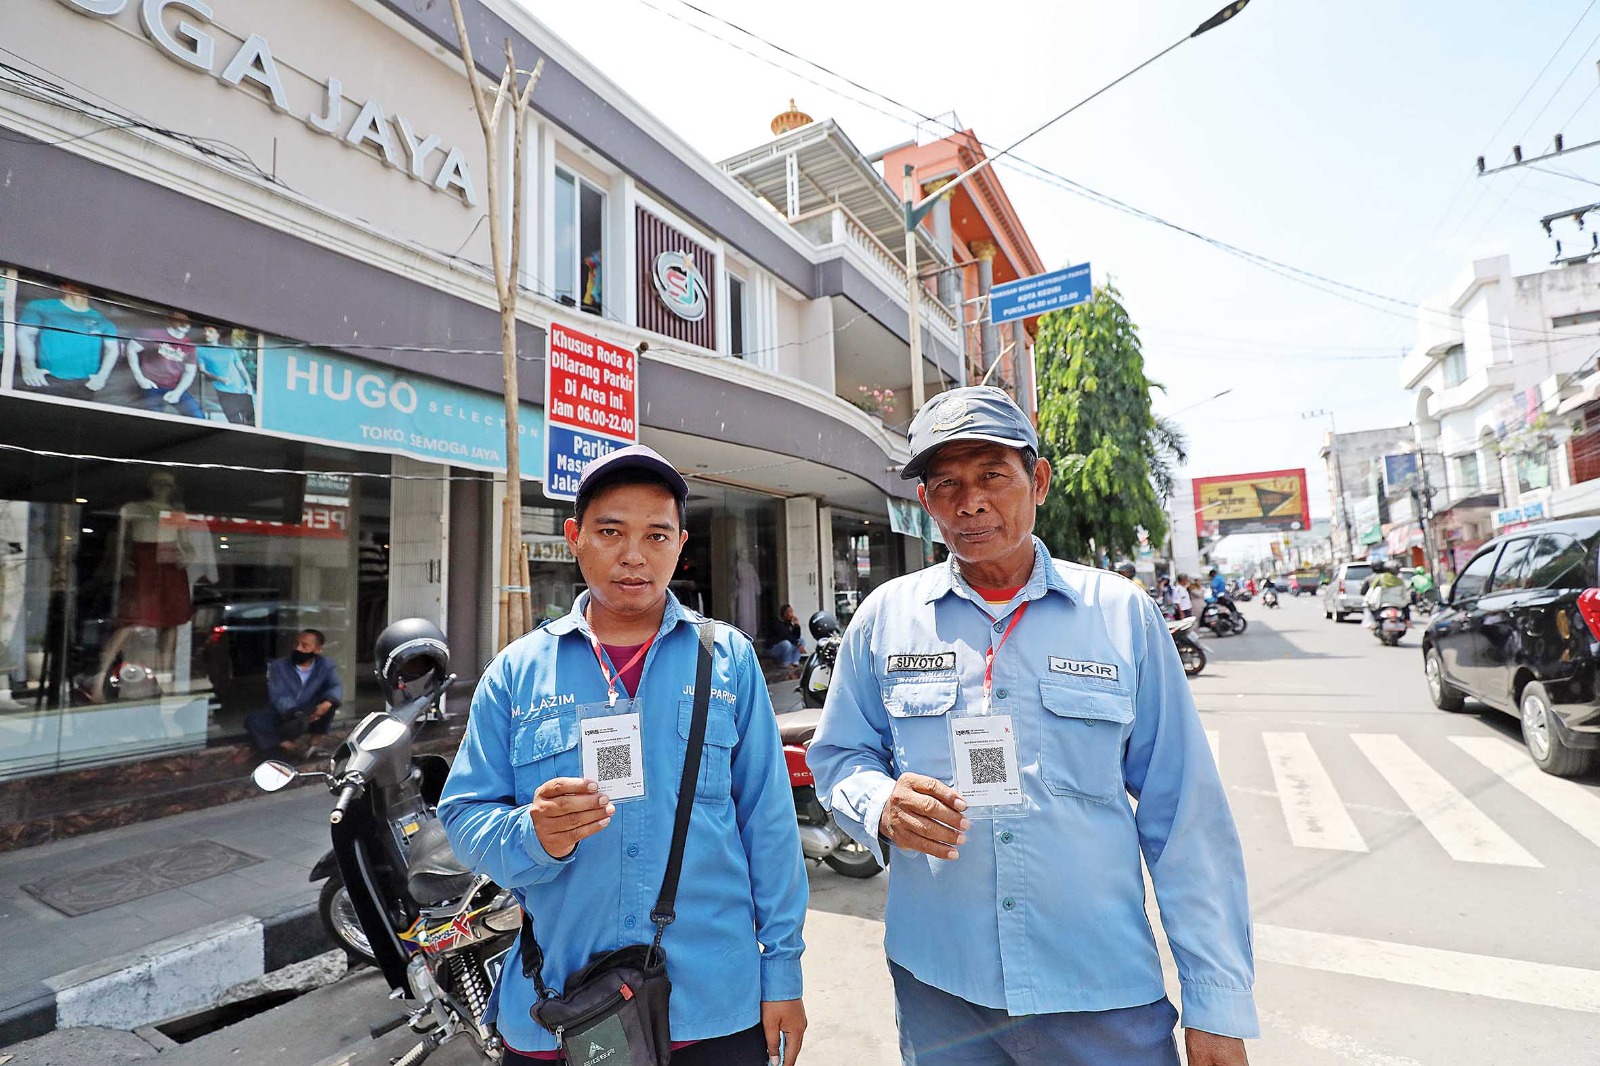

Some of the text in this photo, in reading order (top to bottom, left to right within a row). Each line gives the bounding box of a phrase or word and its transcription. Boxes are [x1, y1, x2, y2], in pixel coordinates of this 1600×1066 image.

[57, 0, 478, 207] GA JAYA
[552, 329, 633, 373] Khusus Roda 4
[551, 351, 633, 392] Dilarang Parkir
[287, 355, 539, 438] HUGO SELECTON
[564, 378, 577, 397] Di
[580, 383, 606, 405] Area
[552, 398, 633, 434] Jam 06.00-22.00
[409, 433, 469, 456] SEMOGA
[470, 446, 500, 461] JAYA
[556, 453, 593, 474] Mas
[896, 656, 944, 669] SUYOTO
[1055, 662, 1112, 676] JUKIR
[511, 693, 575, 718] M. LAZIM
